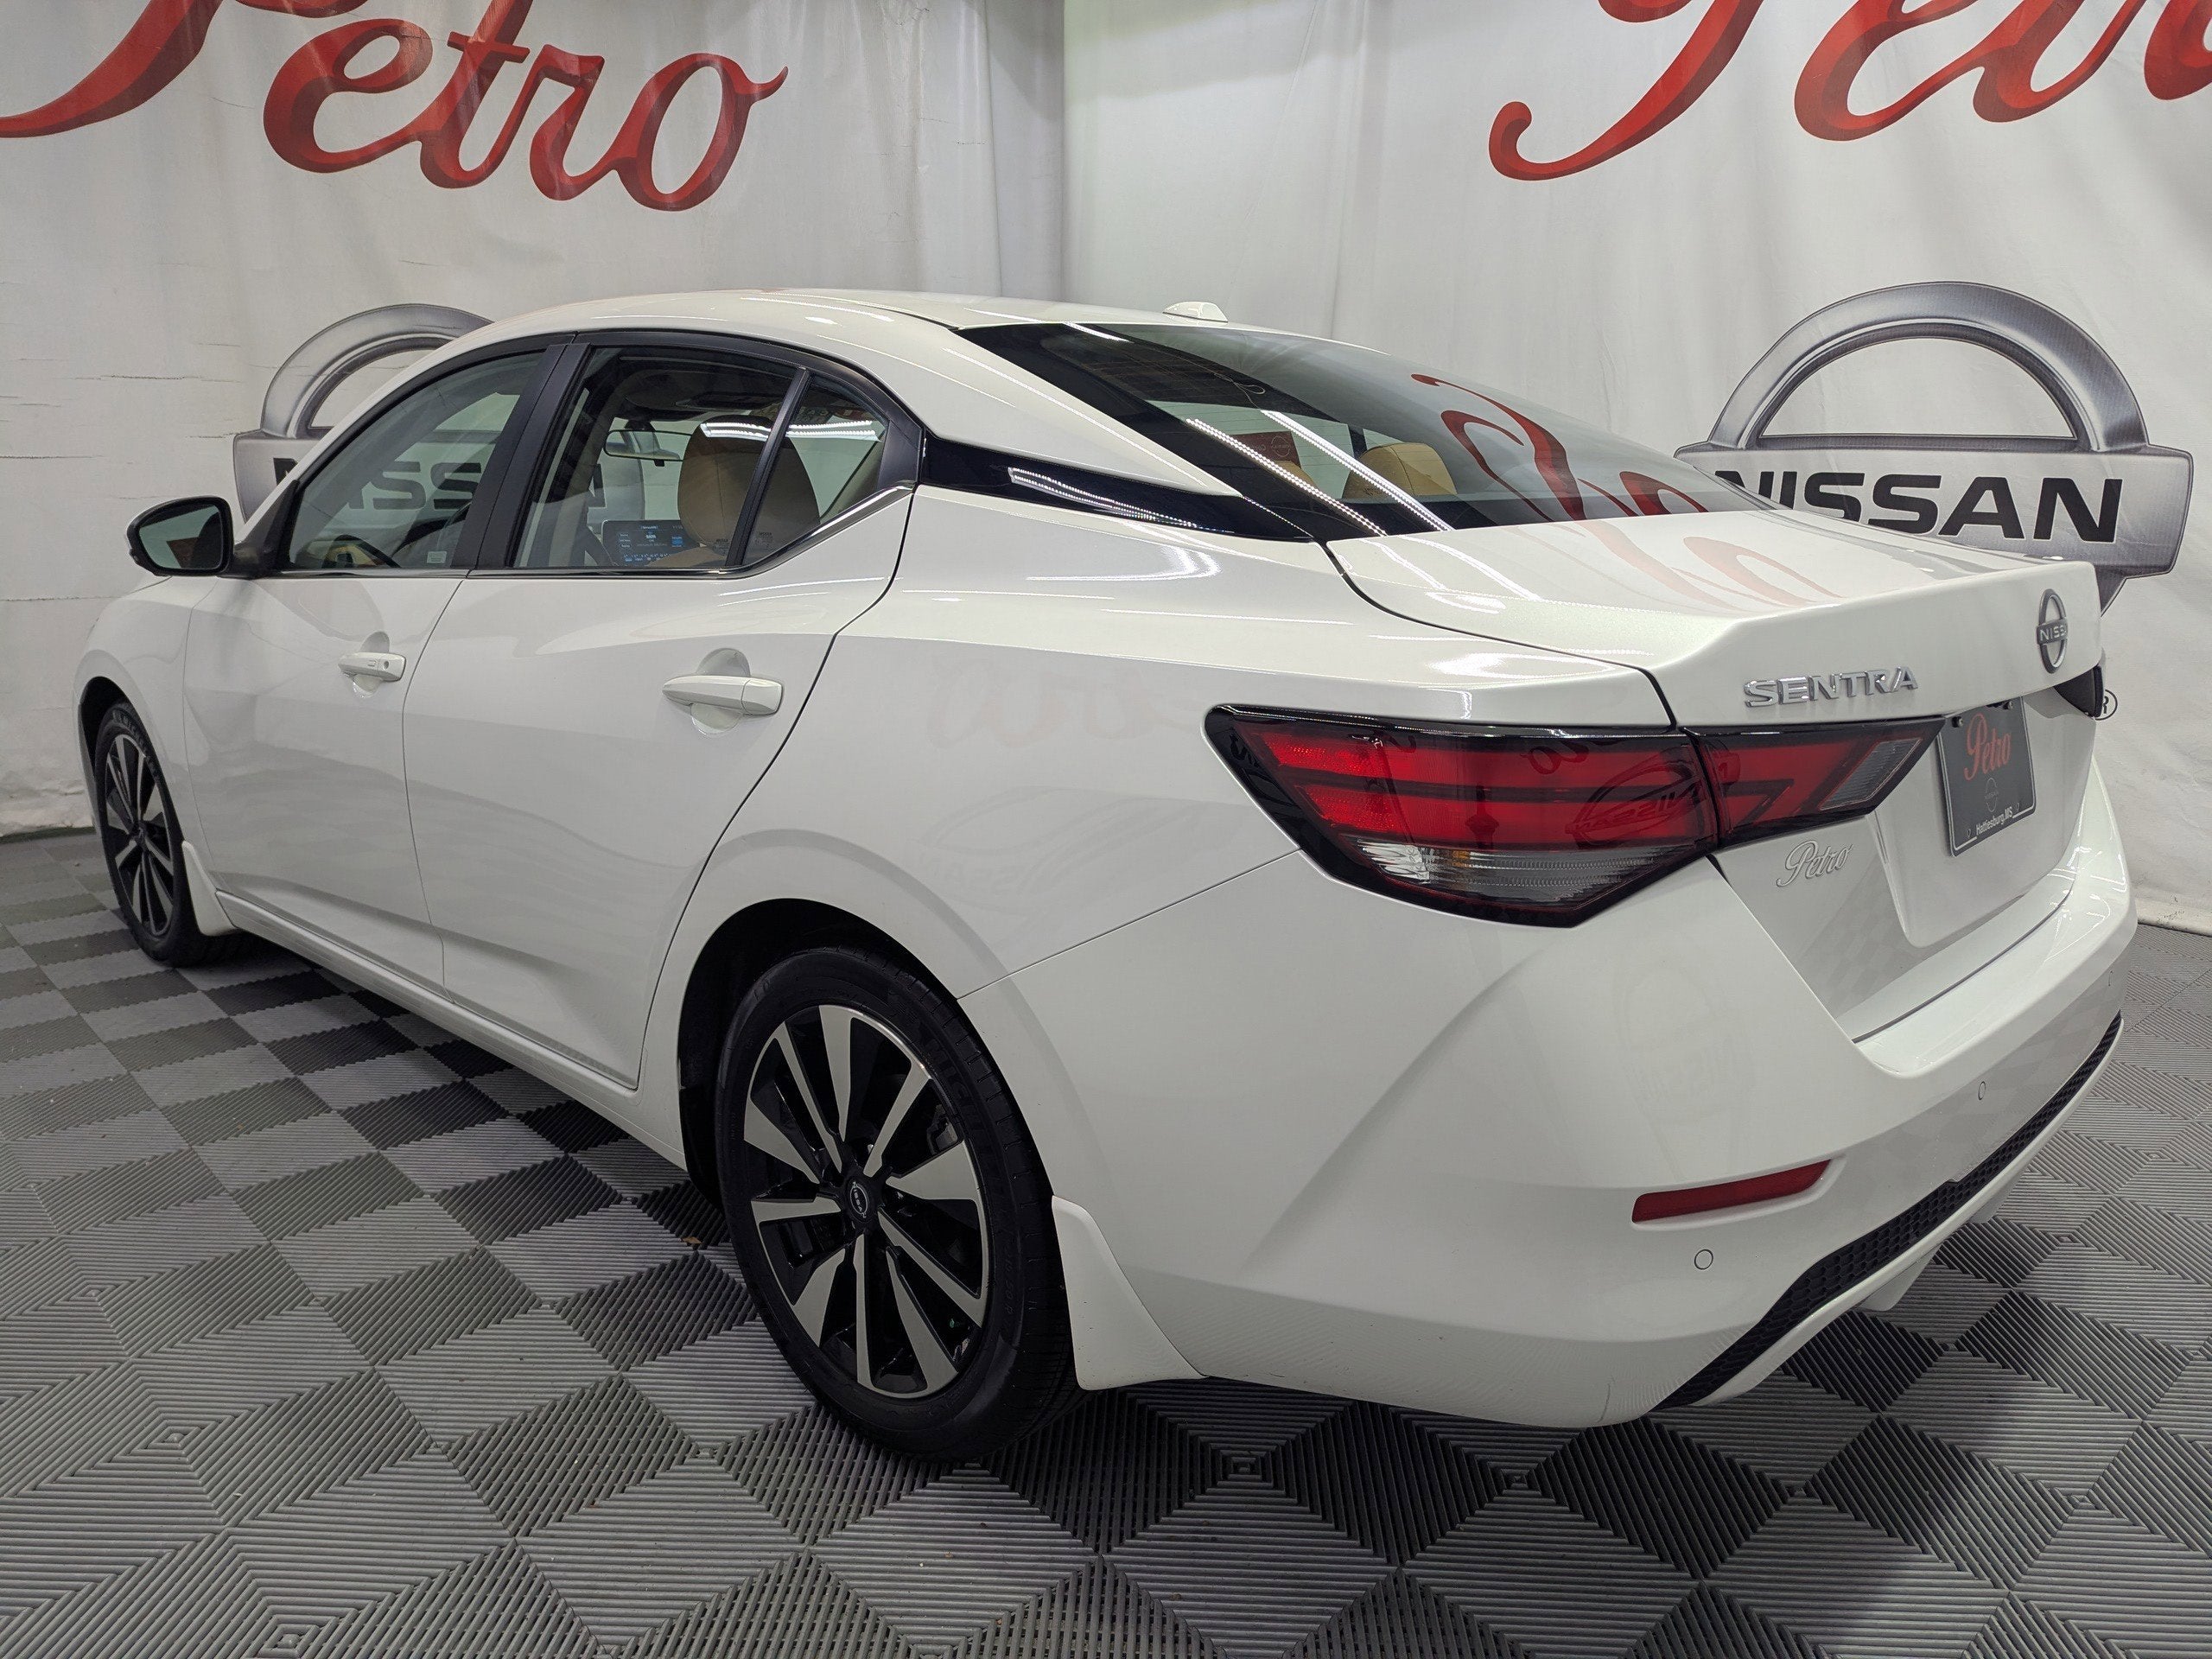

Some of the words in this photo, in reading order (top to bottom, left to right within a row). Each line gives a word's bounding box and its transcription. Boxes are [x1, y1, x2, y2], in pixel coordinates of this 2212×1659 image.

[1744, 666, 1918, 708] SENTRA
[1963, 713, 2012, 781] Petro
[1776, 839, 1853, 887] Petro
